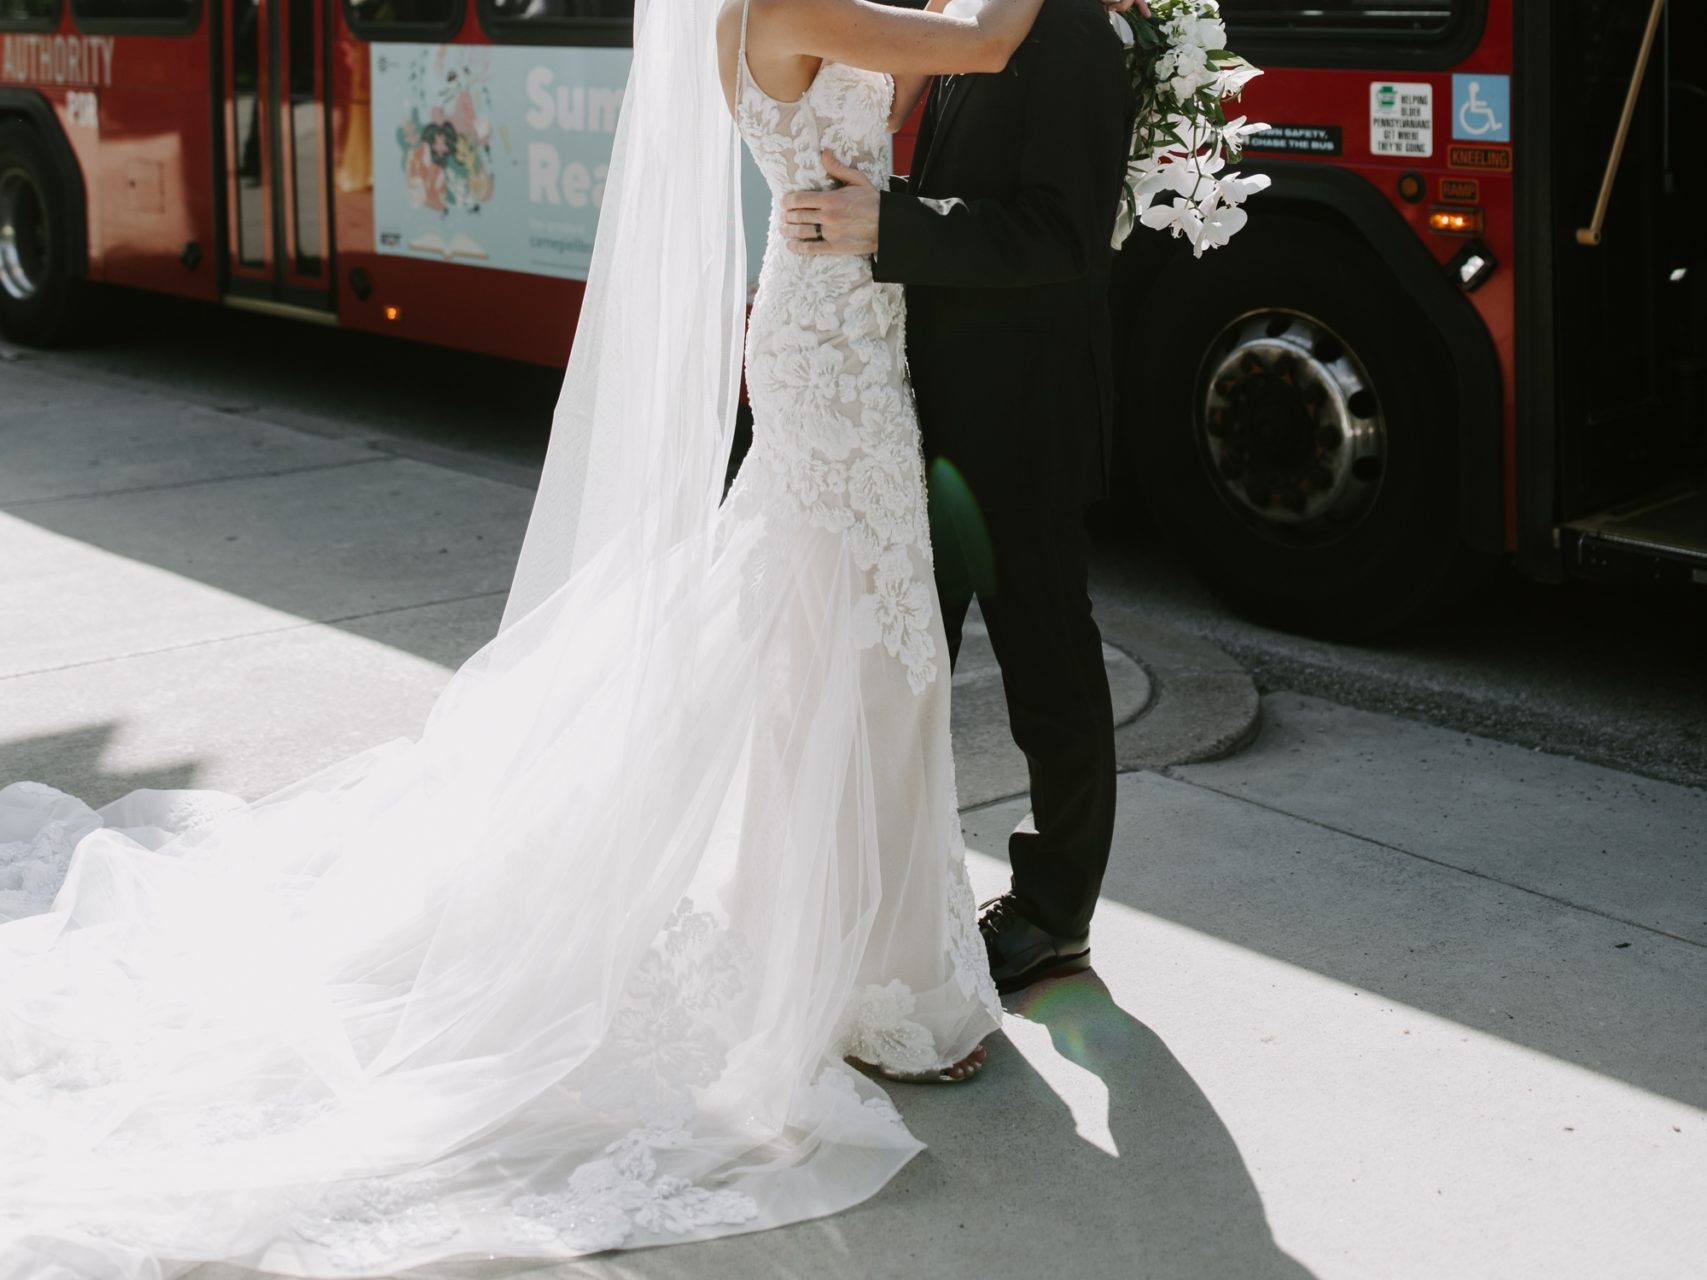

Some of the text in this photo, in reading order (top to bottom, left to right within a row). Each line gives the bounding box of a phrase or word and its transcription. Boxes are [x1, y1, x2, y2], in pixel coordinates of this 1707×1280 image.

[3, 33, 115, 87] AUTHORITY
[1401, 95, 1428, 105] HELPING
[1401, 107, 1421, 116] OLDER
[1373, 118, 1430, 128] PENNSYLVANIANS
[1284, 128, 1329, 140] SAFETY,
[1384, 130, 1419, 140] GET WHERE
[1251, 137, 1287, 148] CHASE
[1289, 140, 1309, 149] THE
[1310, 141, 1335, 151] BUS
[1405, 143, 1425, 152] GOING
[1452, 150, 1508, 166] KNEELING
[1443, 182, 1476, 198] RAMP
